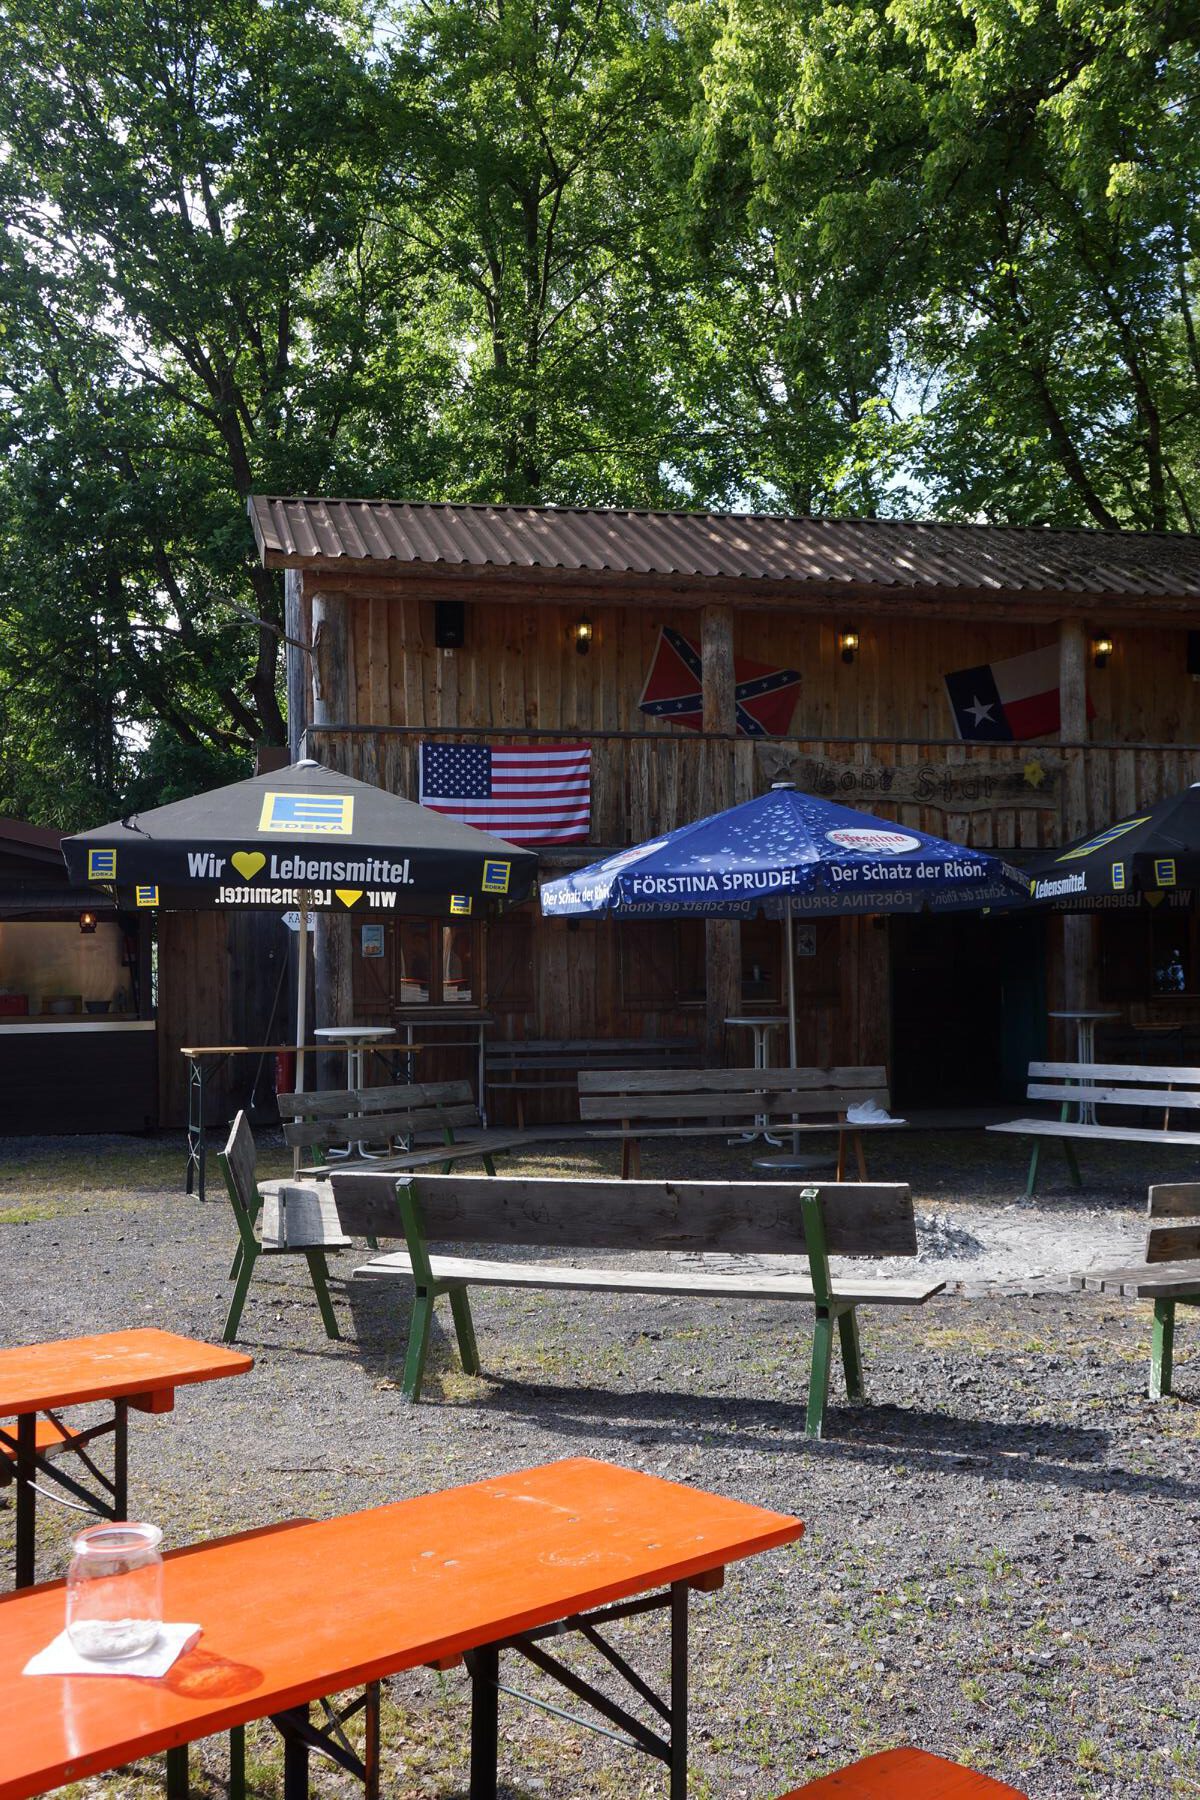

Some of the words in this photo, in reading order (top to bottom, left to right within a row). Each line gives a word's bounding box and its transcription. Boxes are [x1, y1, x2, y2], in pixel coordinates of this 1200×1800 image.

[912, 767, 1000, 803] Star
[270, 823, 344, 831] EDEKA
[187, 853, 226, 878] Wir
[270, 854, 415, 884] Lebensmittel.
[831, 866, 859, 881] Der
[862, 863, 912, 880] Schatz
[916, 862, 940, 879] der
[944, 861, 987, 878] Rhön.
[633, 875, 717, 894] FÖRSTINA
[722, 870, 800, 891] SPRUDEL
[1035, 871, 1087, 899] Lebensmittel.
[543, 891, 557, 905] Der
[558, 888, 580, 905] Schatz
[582, 886, 593, 901] der
